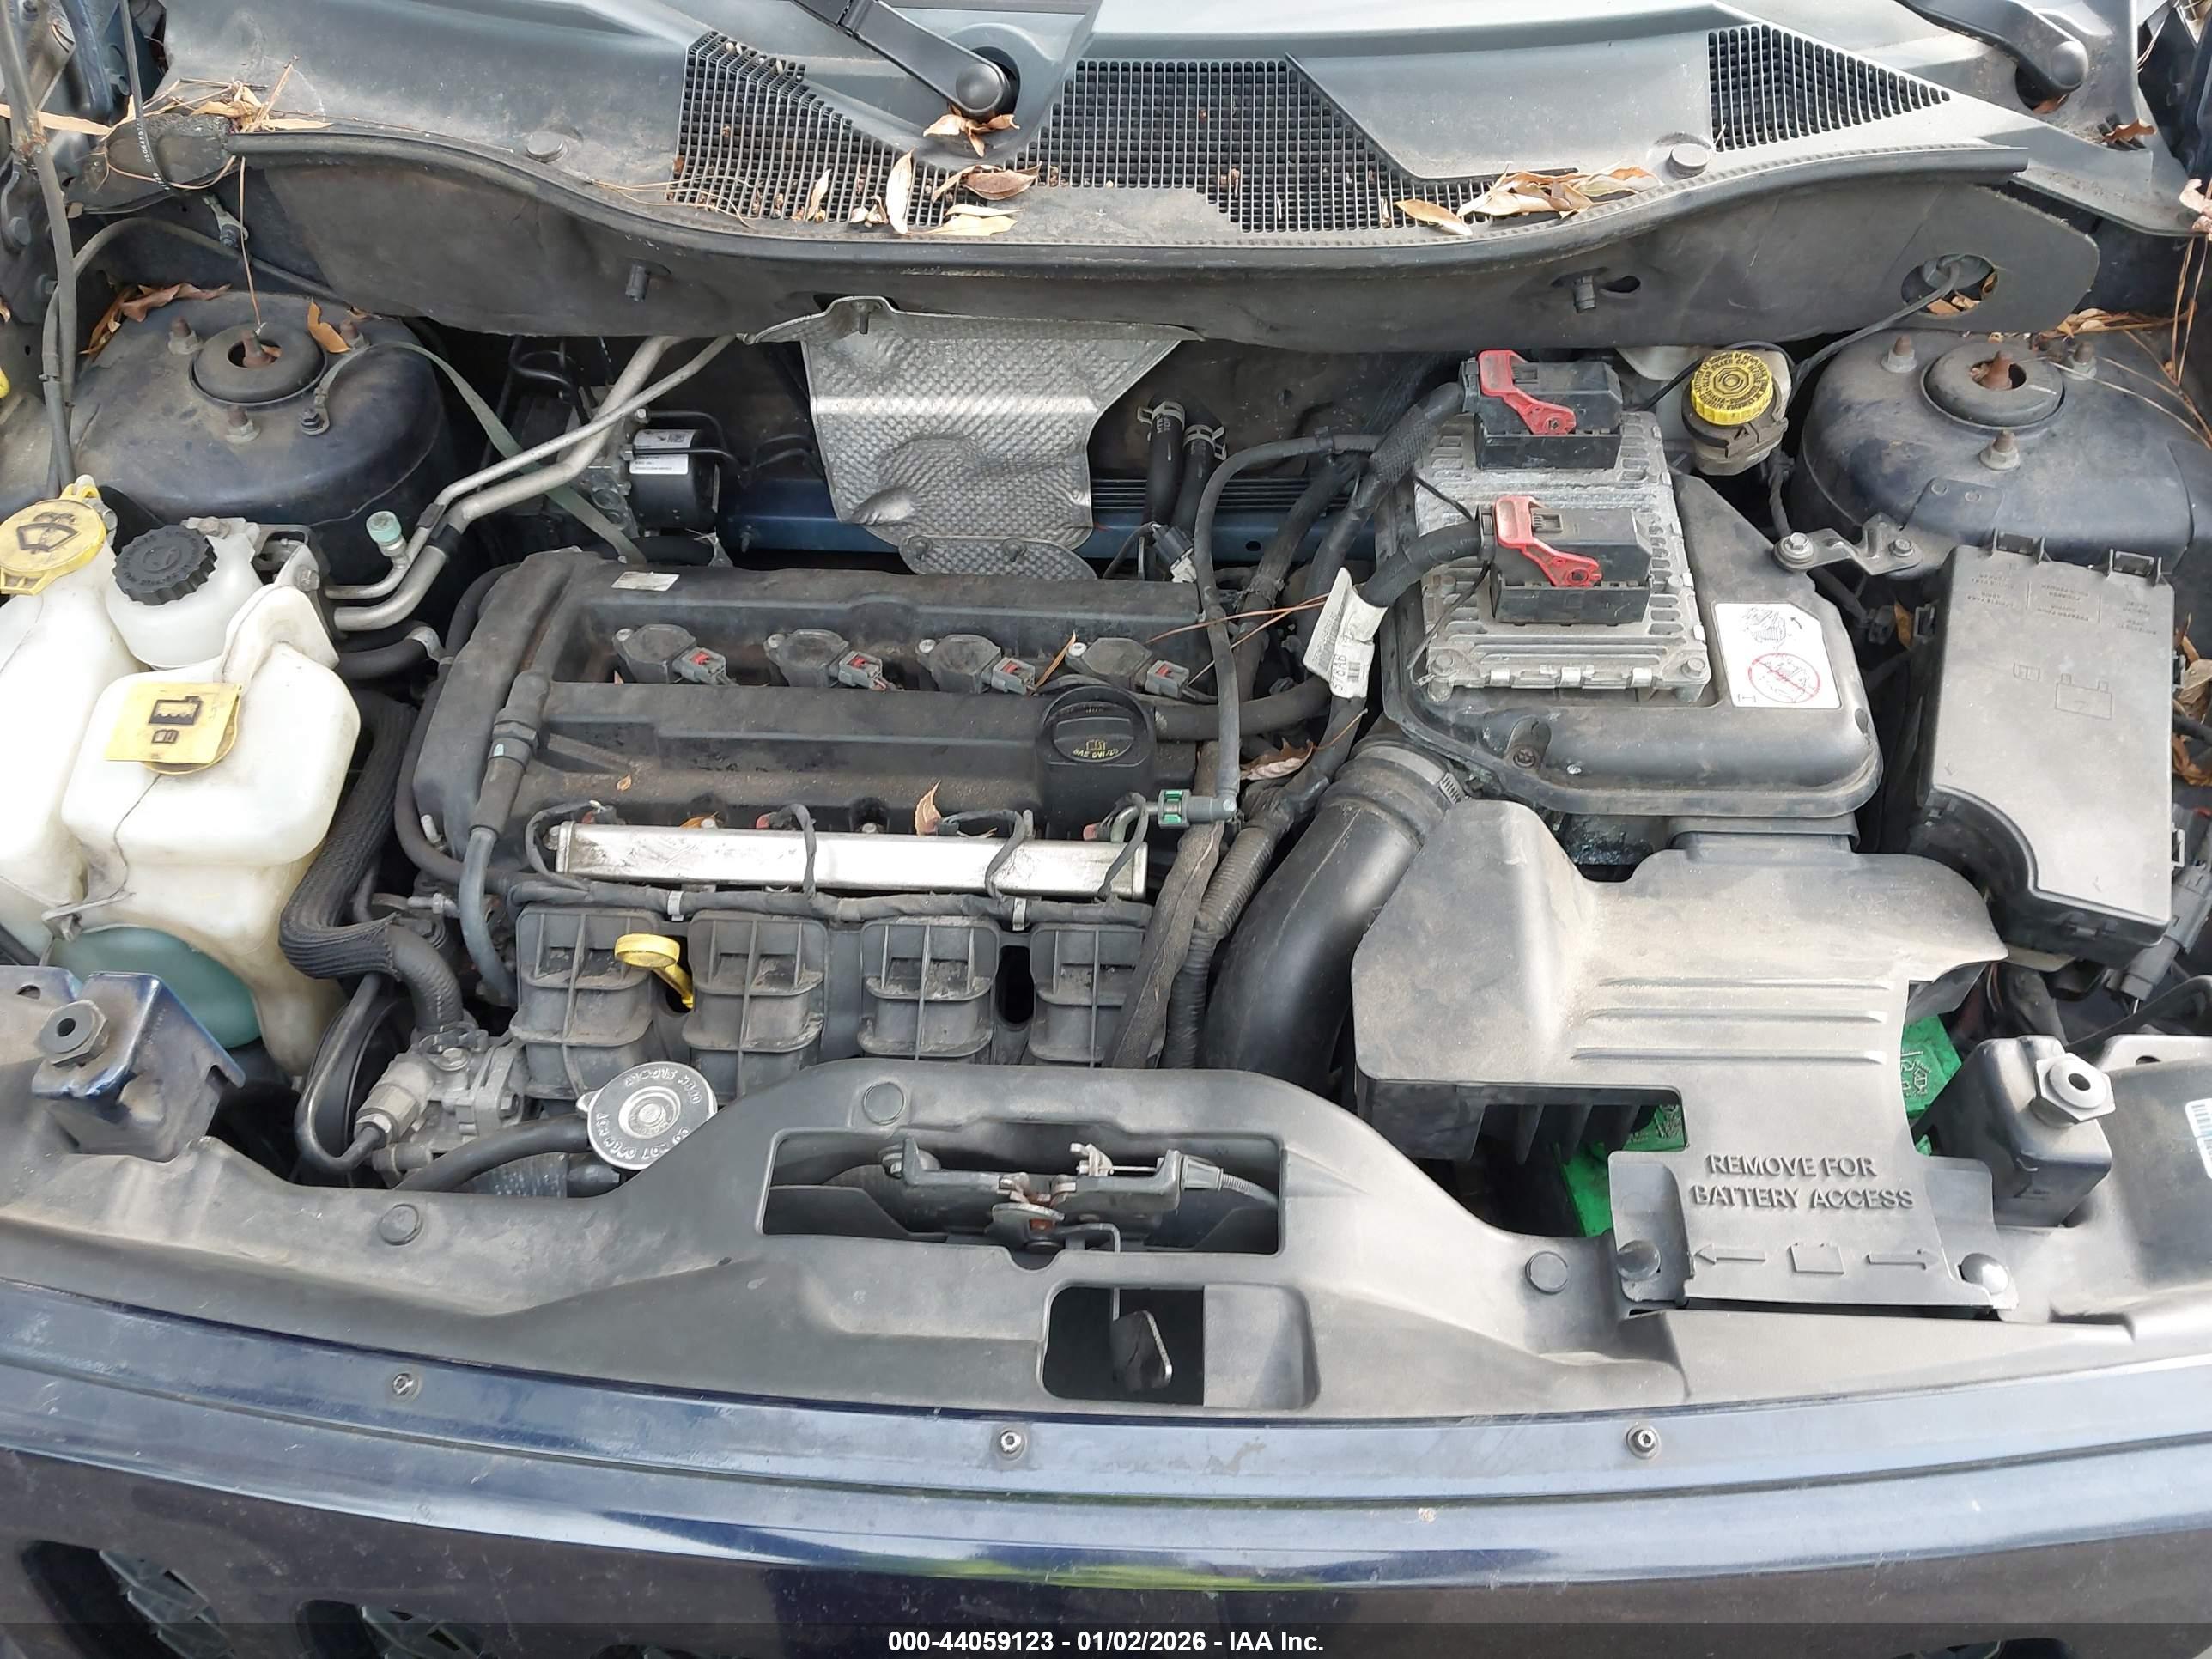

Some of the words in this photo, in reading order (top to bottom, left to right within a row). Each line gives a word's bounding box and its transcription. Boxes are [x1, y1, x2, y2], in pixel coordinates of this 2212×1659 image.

[1706, 1153, 1815, 1178] REMOVE
[1822, 1156, 1877, 1178] FOR
[1691, 1184, 1801, 1209] BATTERY
[1809, 1188, 1915, 1210] ACCESS
